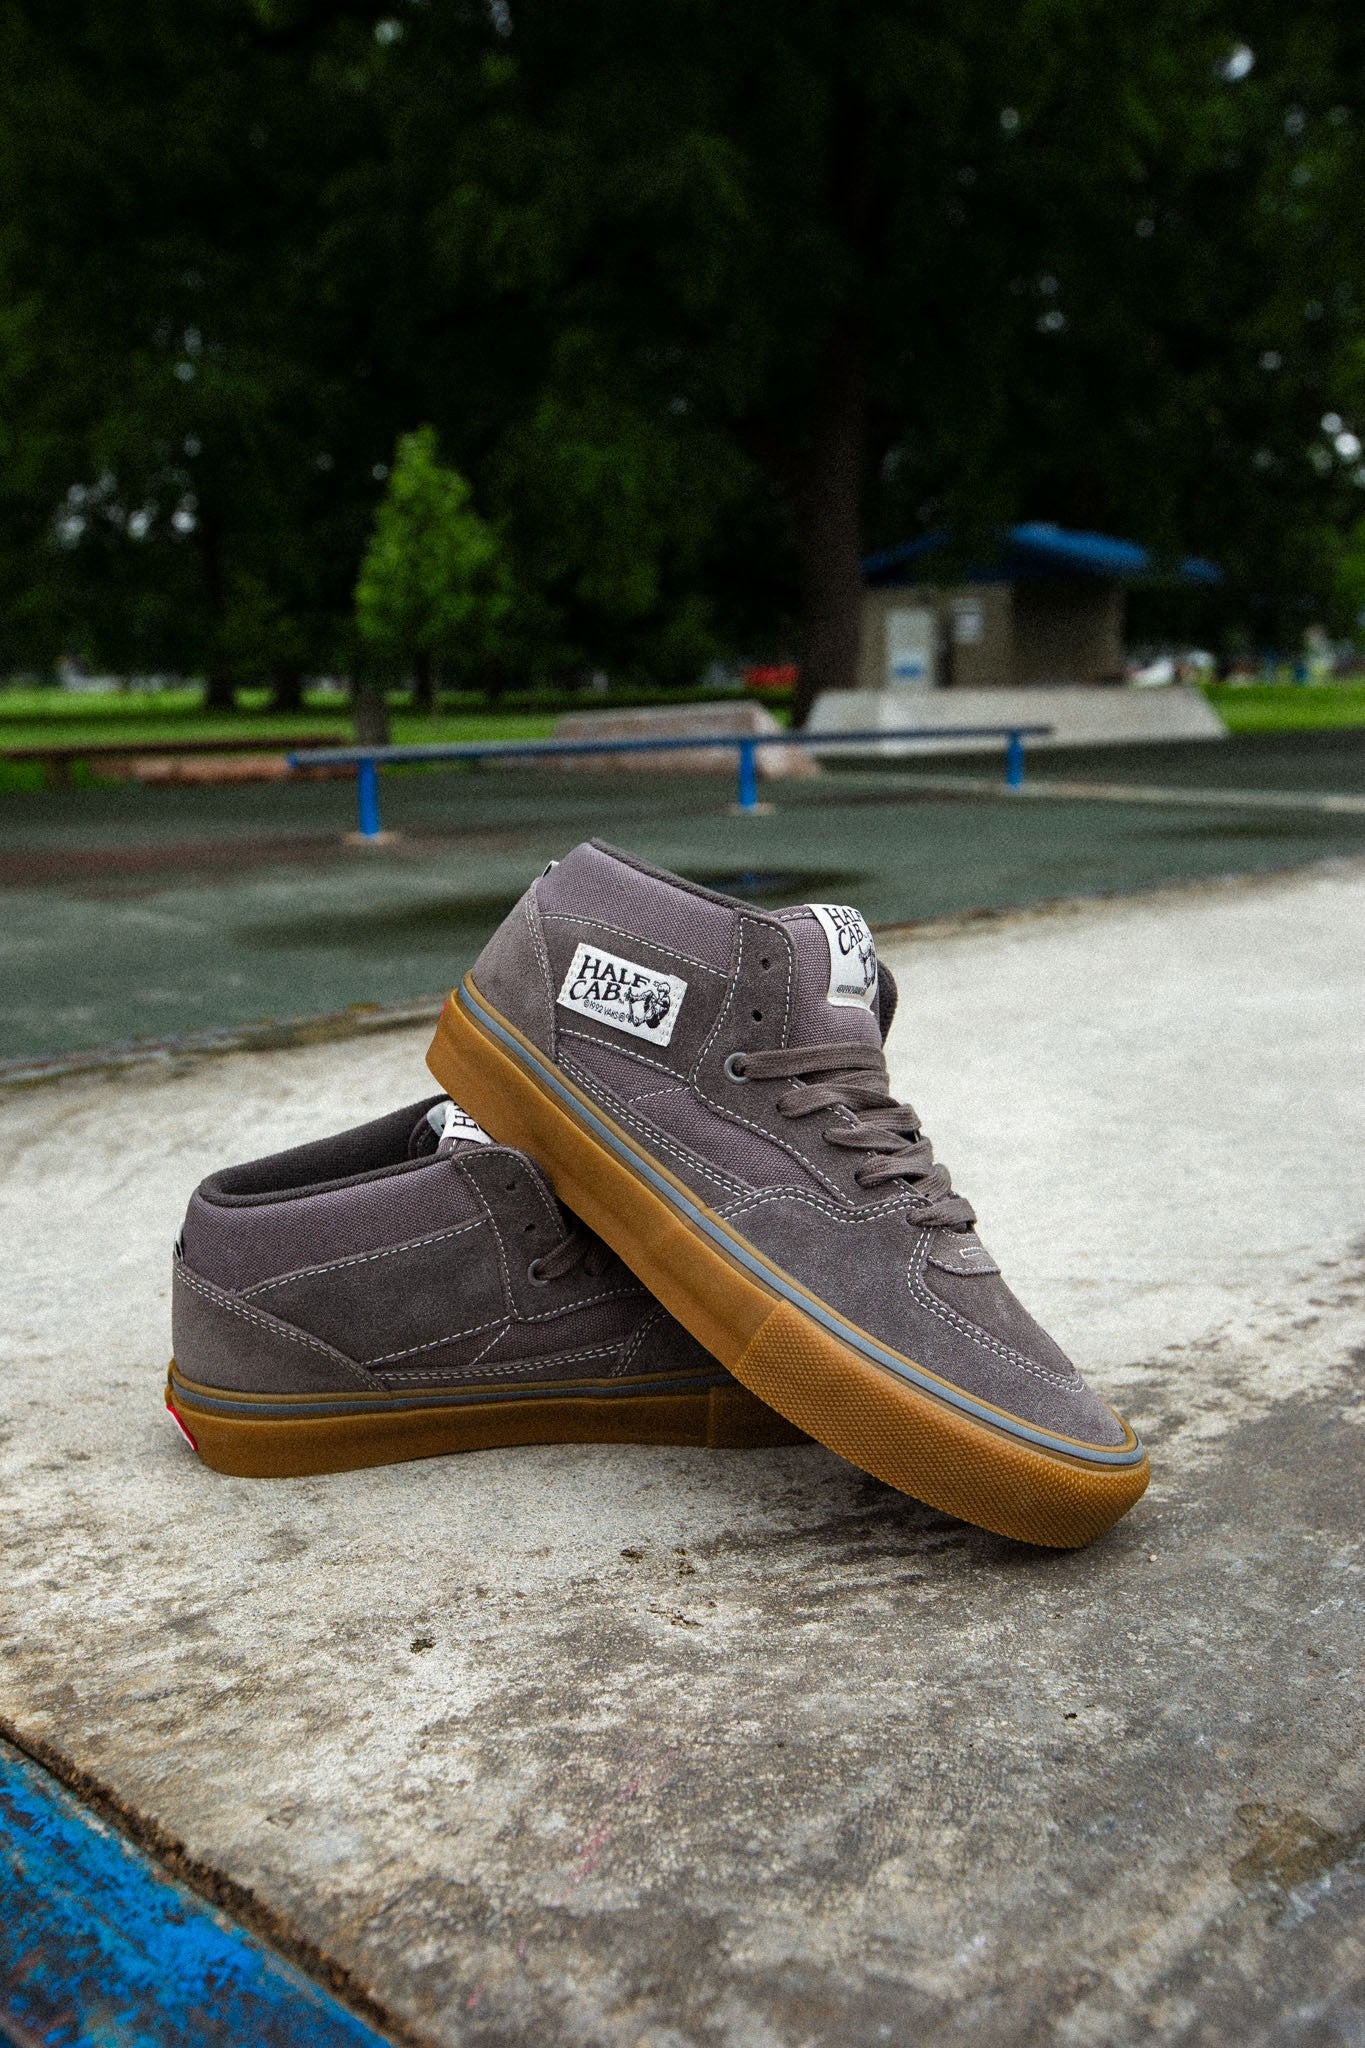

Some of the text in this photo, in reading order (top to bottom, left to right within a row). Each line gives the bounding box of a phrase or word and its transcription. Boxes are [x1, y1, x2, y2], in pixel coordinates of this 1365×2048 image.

[838, 923, 864, 956] CAB
[577, 955, 650, 987] HALF
[569, 980, 621, 1001] CAB
